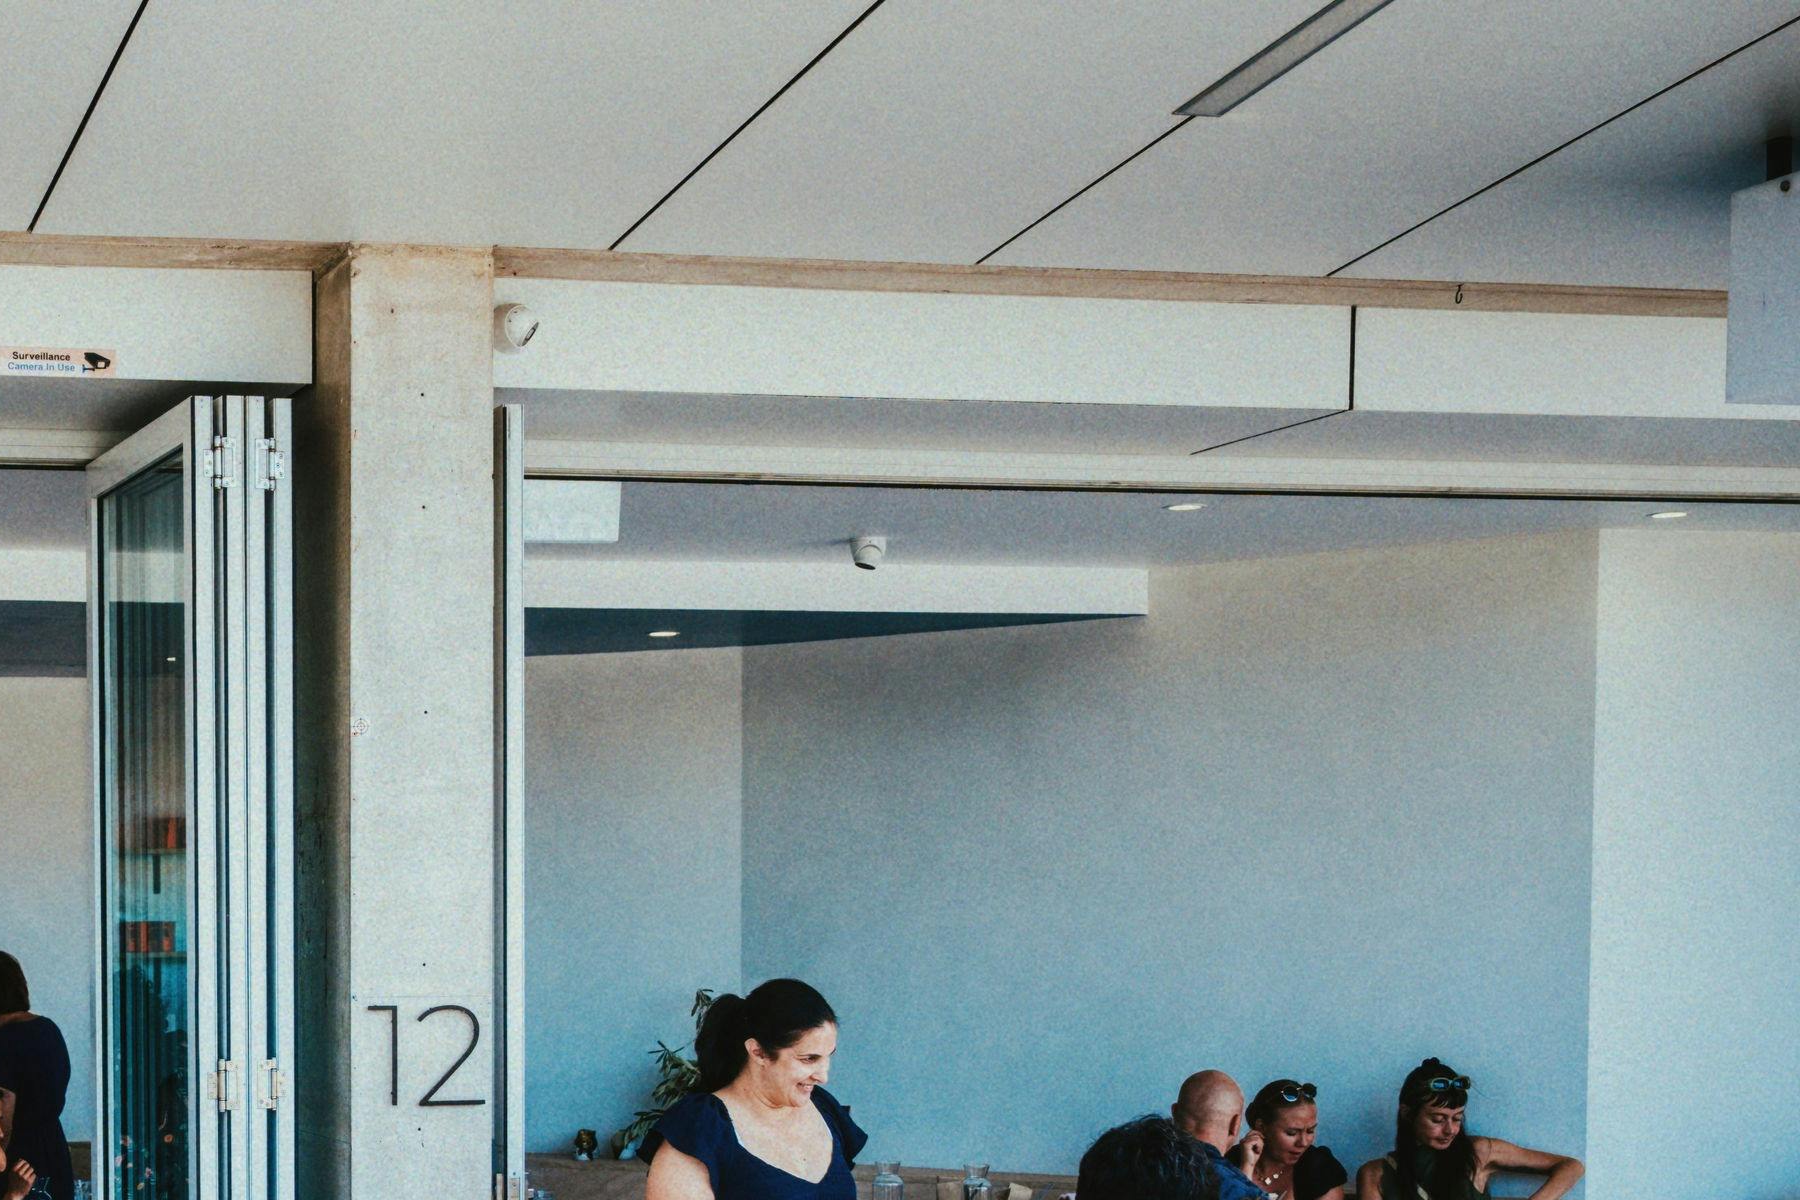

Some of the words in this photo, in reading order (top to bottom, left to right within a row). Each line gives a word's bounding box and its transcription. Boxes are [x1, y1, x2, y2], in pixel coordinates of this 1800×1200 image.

[12, 351, 71, 362] Surveillance
[7, 361, 43, 371] Camera
[46, 363, 55, 372] In
[57, 363, 76, 372] Use
[367, 1004, 486, 1107] 12
